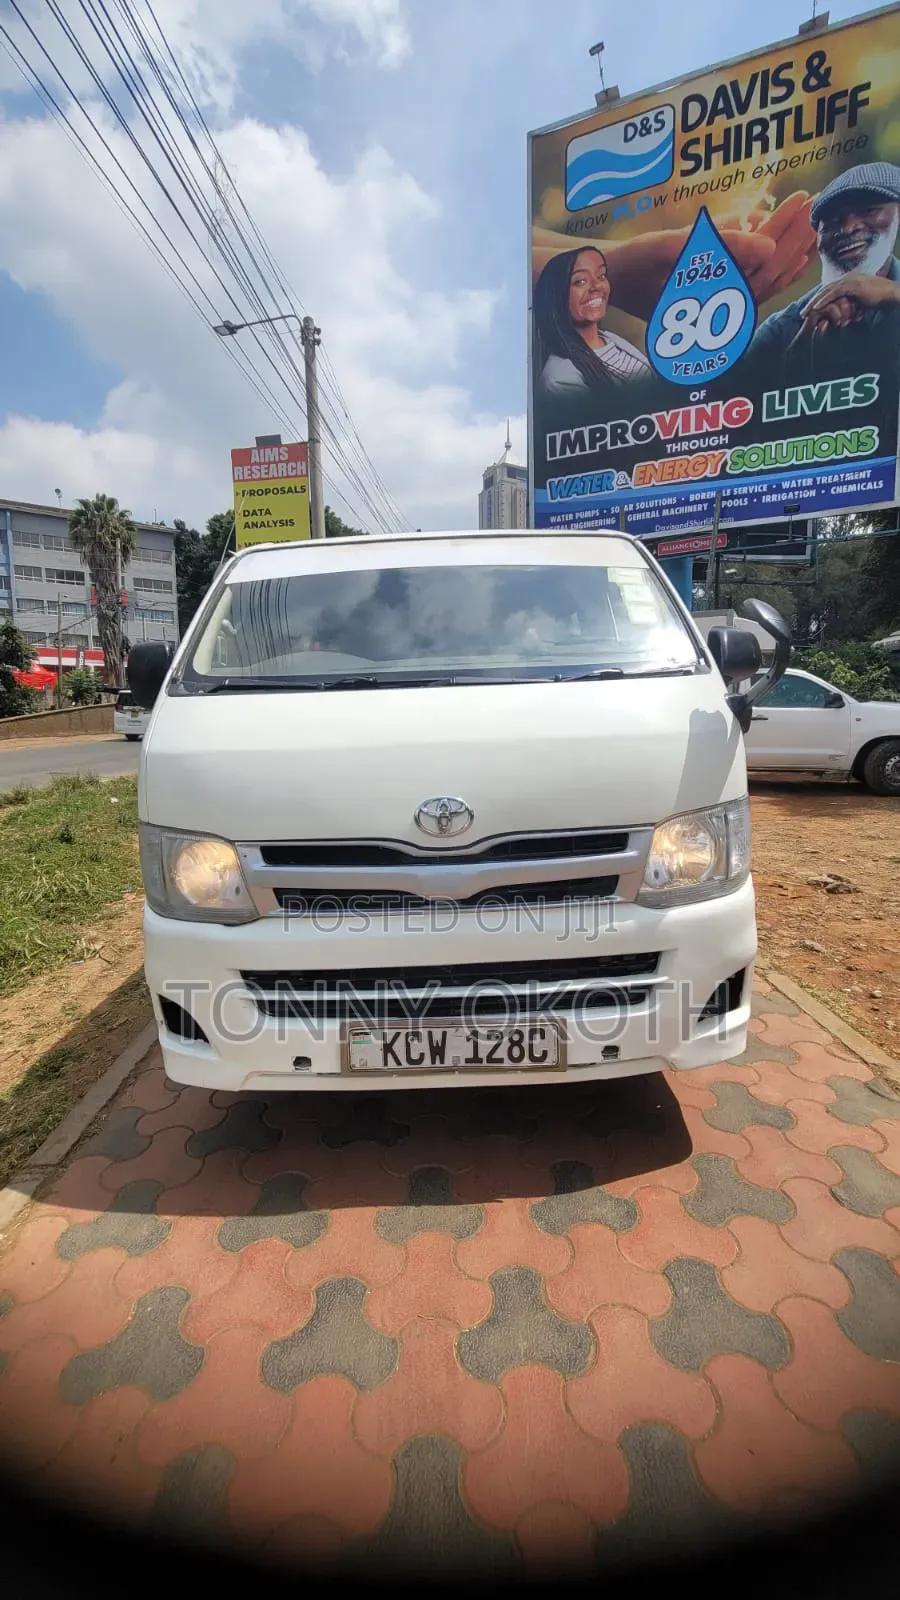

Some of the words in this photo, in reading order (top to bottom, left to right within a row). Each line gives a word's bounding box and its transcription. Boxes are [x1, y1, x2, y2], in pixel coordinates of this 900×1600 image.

[681, 61, 795, 133] DAVIS
[801, 50, 832, 93] &
[623, 110, 666, 143] D&S
[680, 81, 871, 177] SHIRTLIFF
[566, 212, 608, 234] know
[673, 168, 745, 202] through
[752, 134, 869, 179] experience
[675, 259, 727, 288] 1946
[691, 251, 714, 267] EST
[654, 287, 747, 359] 80
[672, 352, 728, 376] YEARS
[689, 390, 707, 401] OF
[547, 396, 753, 461] IMPROVING
[762, 373, 880, 422] LIVES
[251, 447, 288, 463] AIMS
[666, 434, 729, 454] THROUGH
[234, 461, 307, 480] RESEARCH
[547, 469, 617, 502] WATER
[616, 471, 631, 488] &
[632, 450, 728, 489] ENERGY
[726, 426, 879, 473] SOLUTIONS
[242, 485, 307, 498] PROPOSALS
[550, 514, 573, 523] WATER
[575, 509, 599, 519] PUMPS
[611, 503, 634, 514] SOAR
[636, 497, 677, 510] SOLUTIONS
[689, 489, 731, 502] BOREHLE
[733, 484, 768, 495] SERVICE
[782, 478, 813, 489] WATER
[816, 470, 872, 485] TREATMENT
[627, 510, 660, 522] GENERAL
[662, 503, 708, 517] MACHINERY
[721, 498, 748, 508] POOLS
[762, 489, 816, 503] IRRIGATION
[831, 480, 884, 495] CHEMICALS
[243, 508, 272, 517] DATA
[243, 519, 295, 530] ANALYSIS
[382, 1030, 448, 1066] KCW
[464, 1027, 549, 1064] 128C
